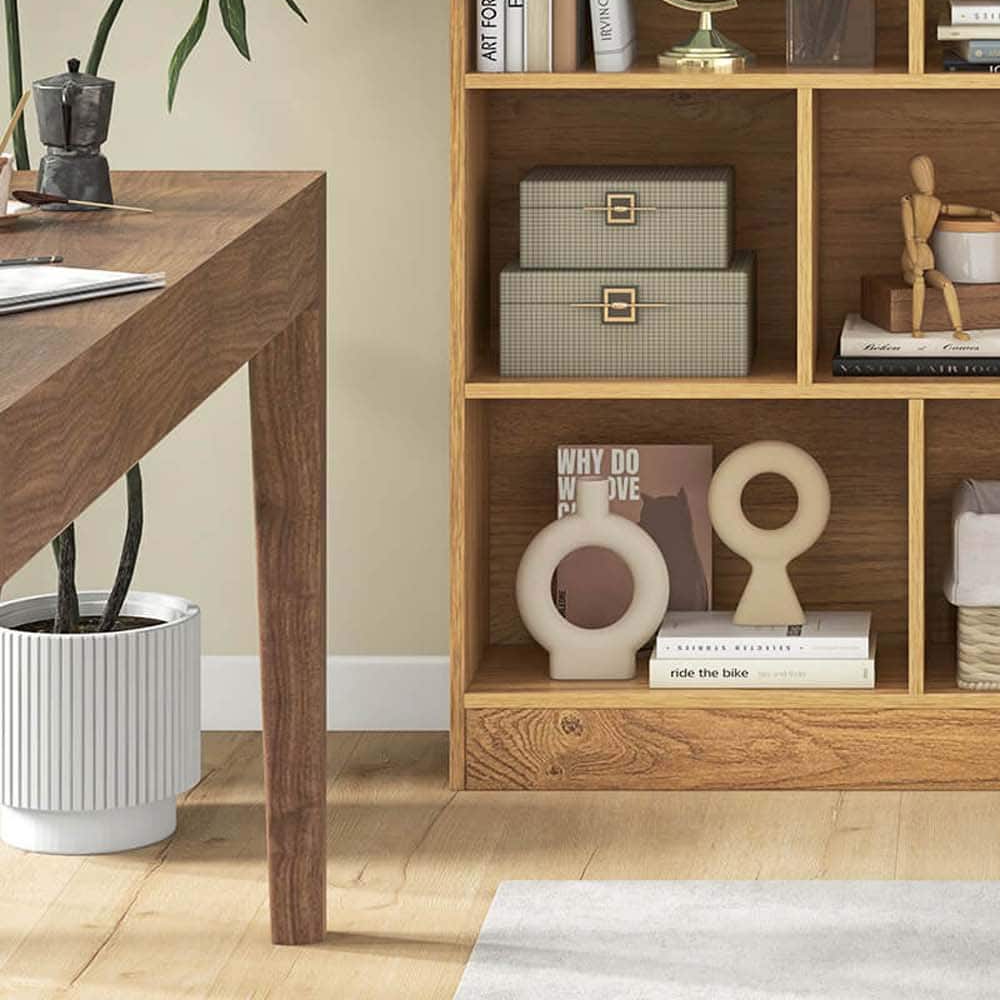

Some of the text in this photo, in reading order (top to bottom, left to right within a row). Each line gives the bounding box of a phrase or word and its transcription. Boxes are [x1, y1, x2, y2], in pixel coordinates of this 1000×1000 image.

[481, 0, 497, 29] FOR
[481, 35, 498, 61] ART
[558, 448, 640, 475] WHY DO
[558, 476, 640, 500] W OVE
[670, 667, 695, 678] ride
[699, 667, 719, 678] the
[722, 667, 749, 678] bike
